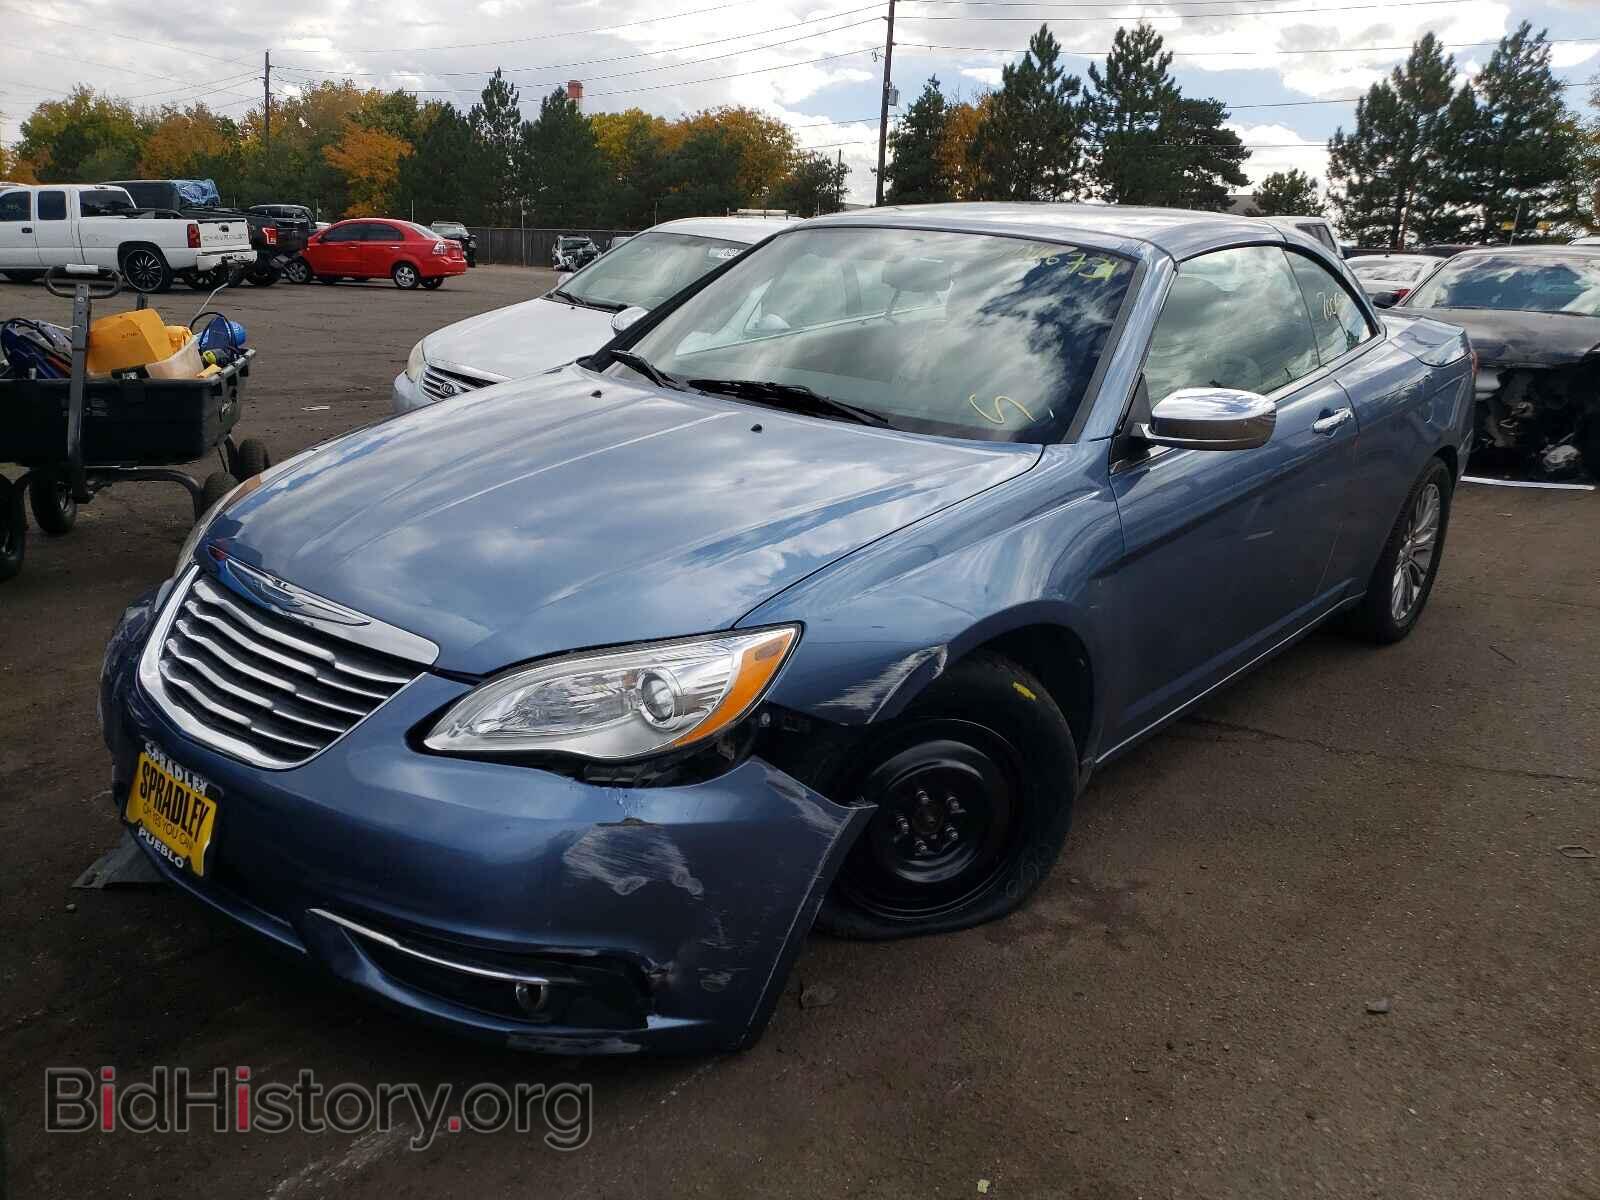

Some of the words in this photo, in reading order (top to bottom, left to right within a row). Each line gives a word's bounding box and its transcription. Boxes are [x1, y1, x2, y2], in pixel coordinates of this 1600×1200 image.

[144, 742, 209, 796] SPRADLEY
[139, 761, 210, 843] SPRADLEY
[137, 827, 185, 869] PUEBLO
